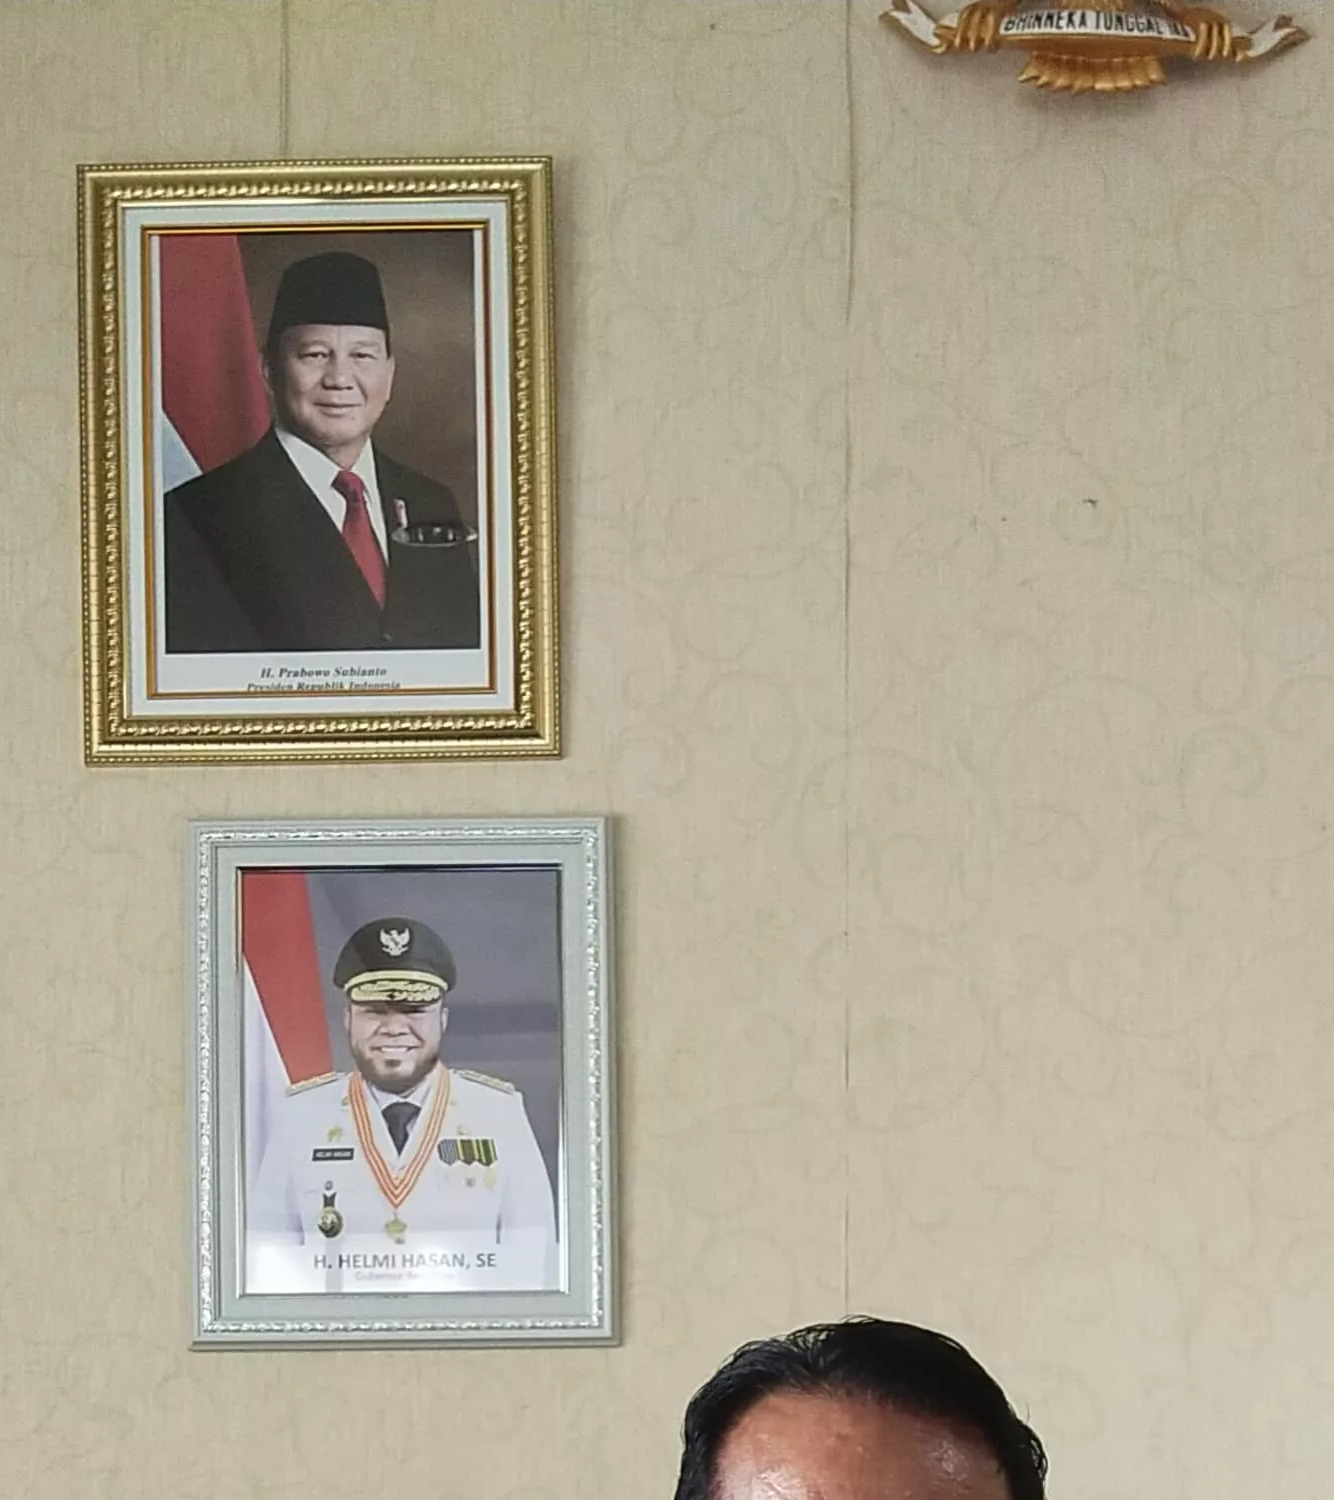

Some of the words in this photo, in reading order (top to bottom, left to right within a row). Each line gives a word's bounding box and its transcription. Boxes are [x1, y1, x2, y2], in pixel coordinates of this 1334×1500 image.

[1003, 10, 1089, 33] BHINNEKA
[1095, 11, 1163, 34] TUNGGAL
[278, 667, 331, 679] Prabowo
[333, 666, 387, 678] Subianto
[313, 1254, 333, 1269] H.
[338, 1253, 397, 1269] HELMI
[401, 1253, 471, 1270] HASAN,
[475, 1252, 497, 1268] SE
